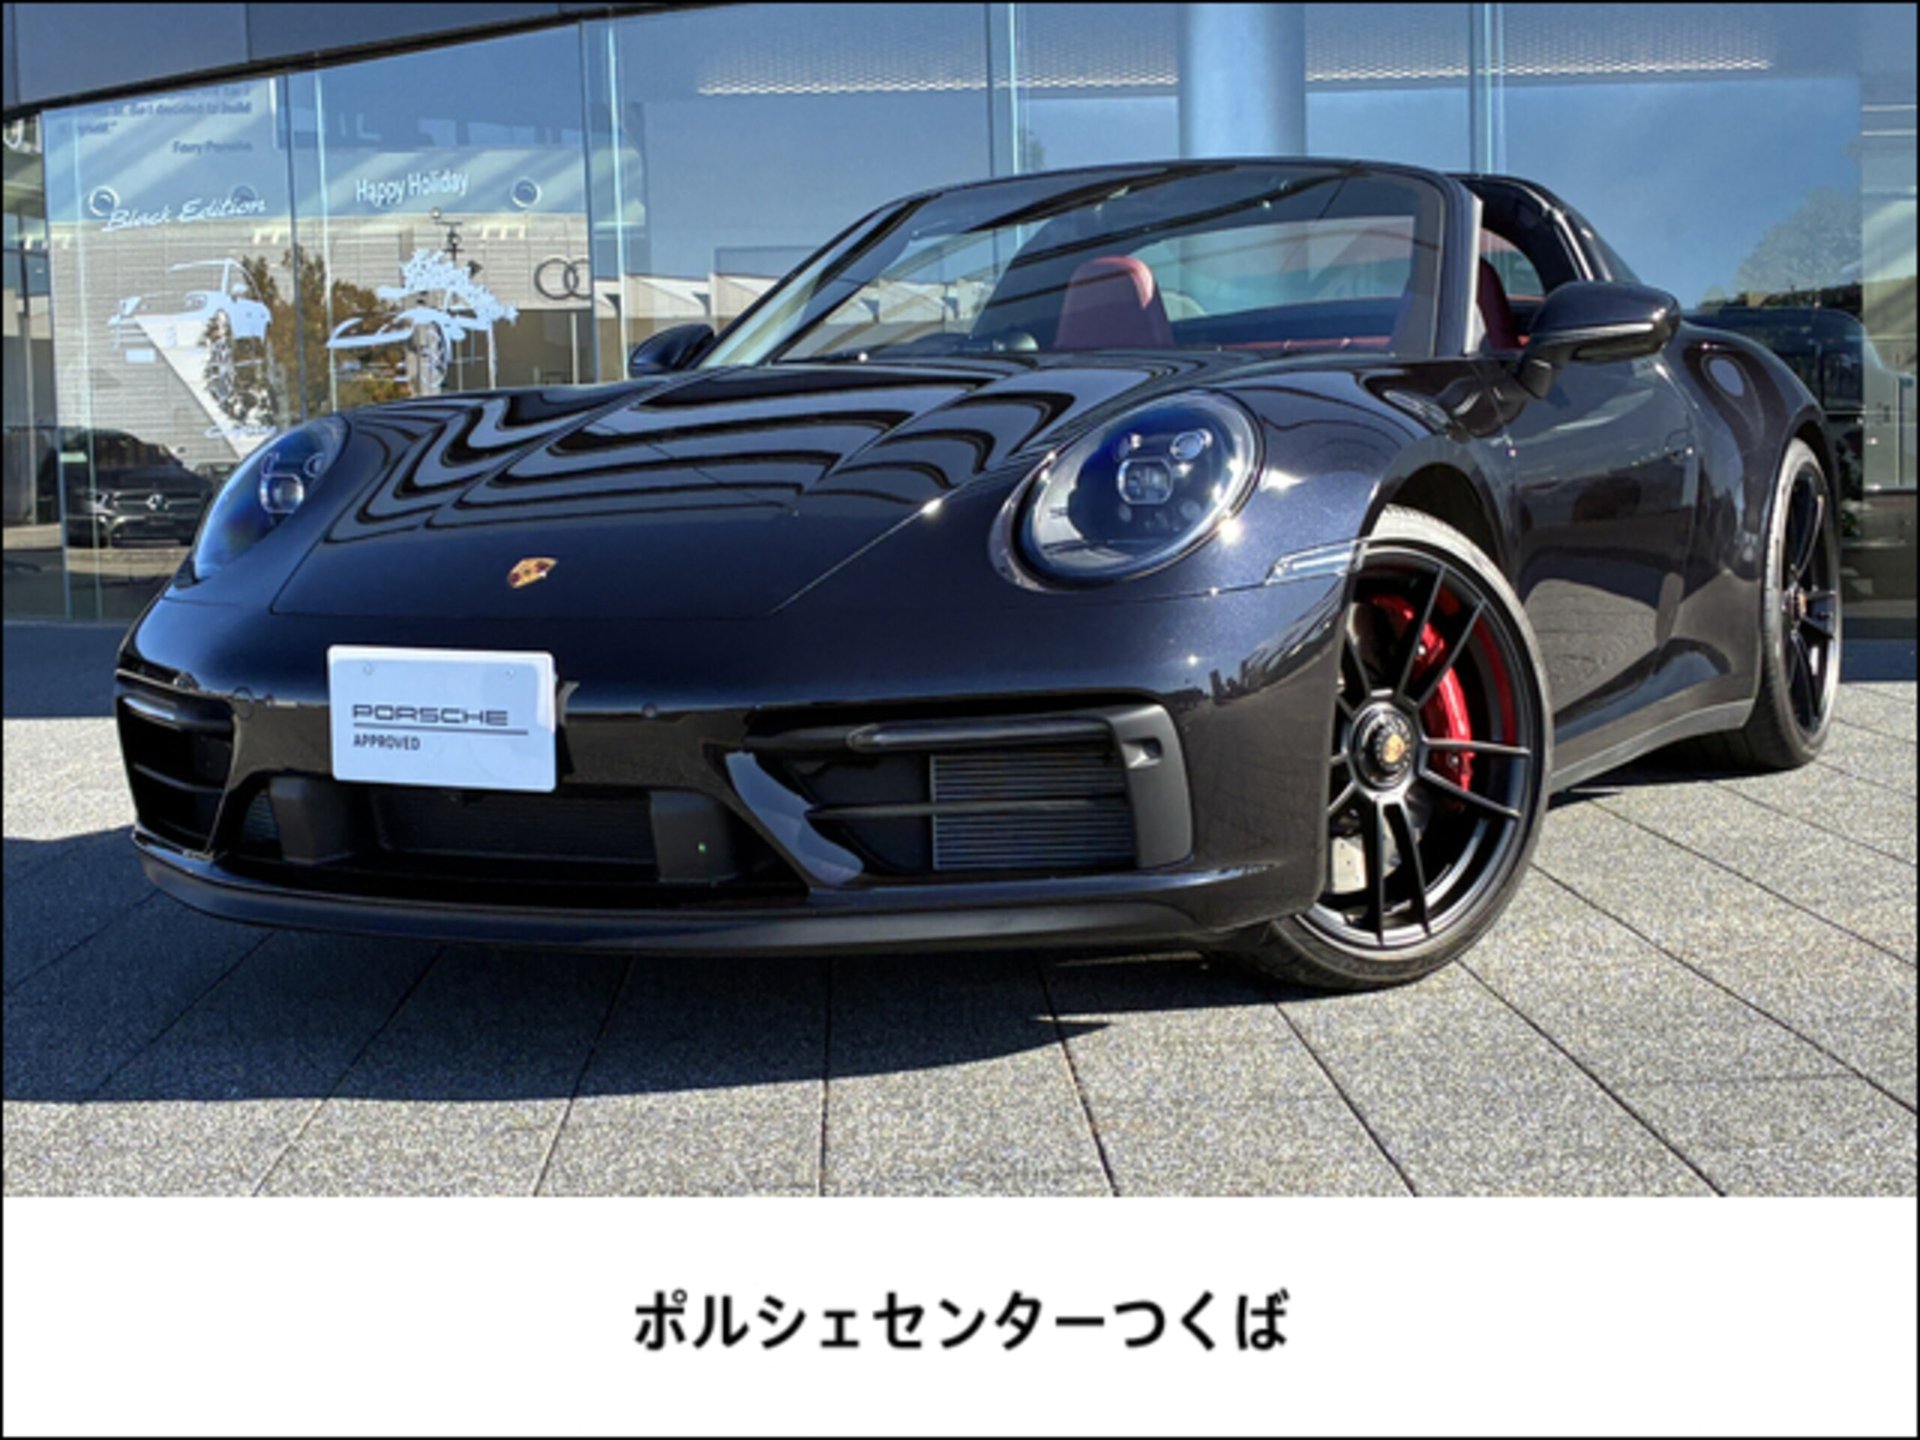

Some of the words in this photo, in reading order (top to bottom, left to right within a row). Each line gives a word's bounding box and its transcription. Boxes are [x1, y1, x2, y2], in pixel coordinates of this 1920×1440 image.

[355, 177, 404, 208] Happy
[407, 168, 469, 199] Holiday
[101, 205, 171, 232] Black
[178, 197, 266, 223] Edition
[352, 703, 509, 727] PORSCHE
[352, 733, 421, 752] APPROVED
